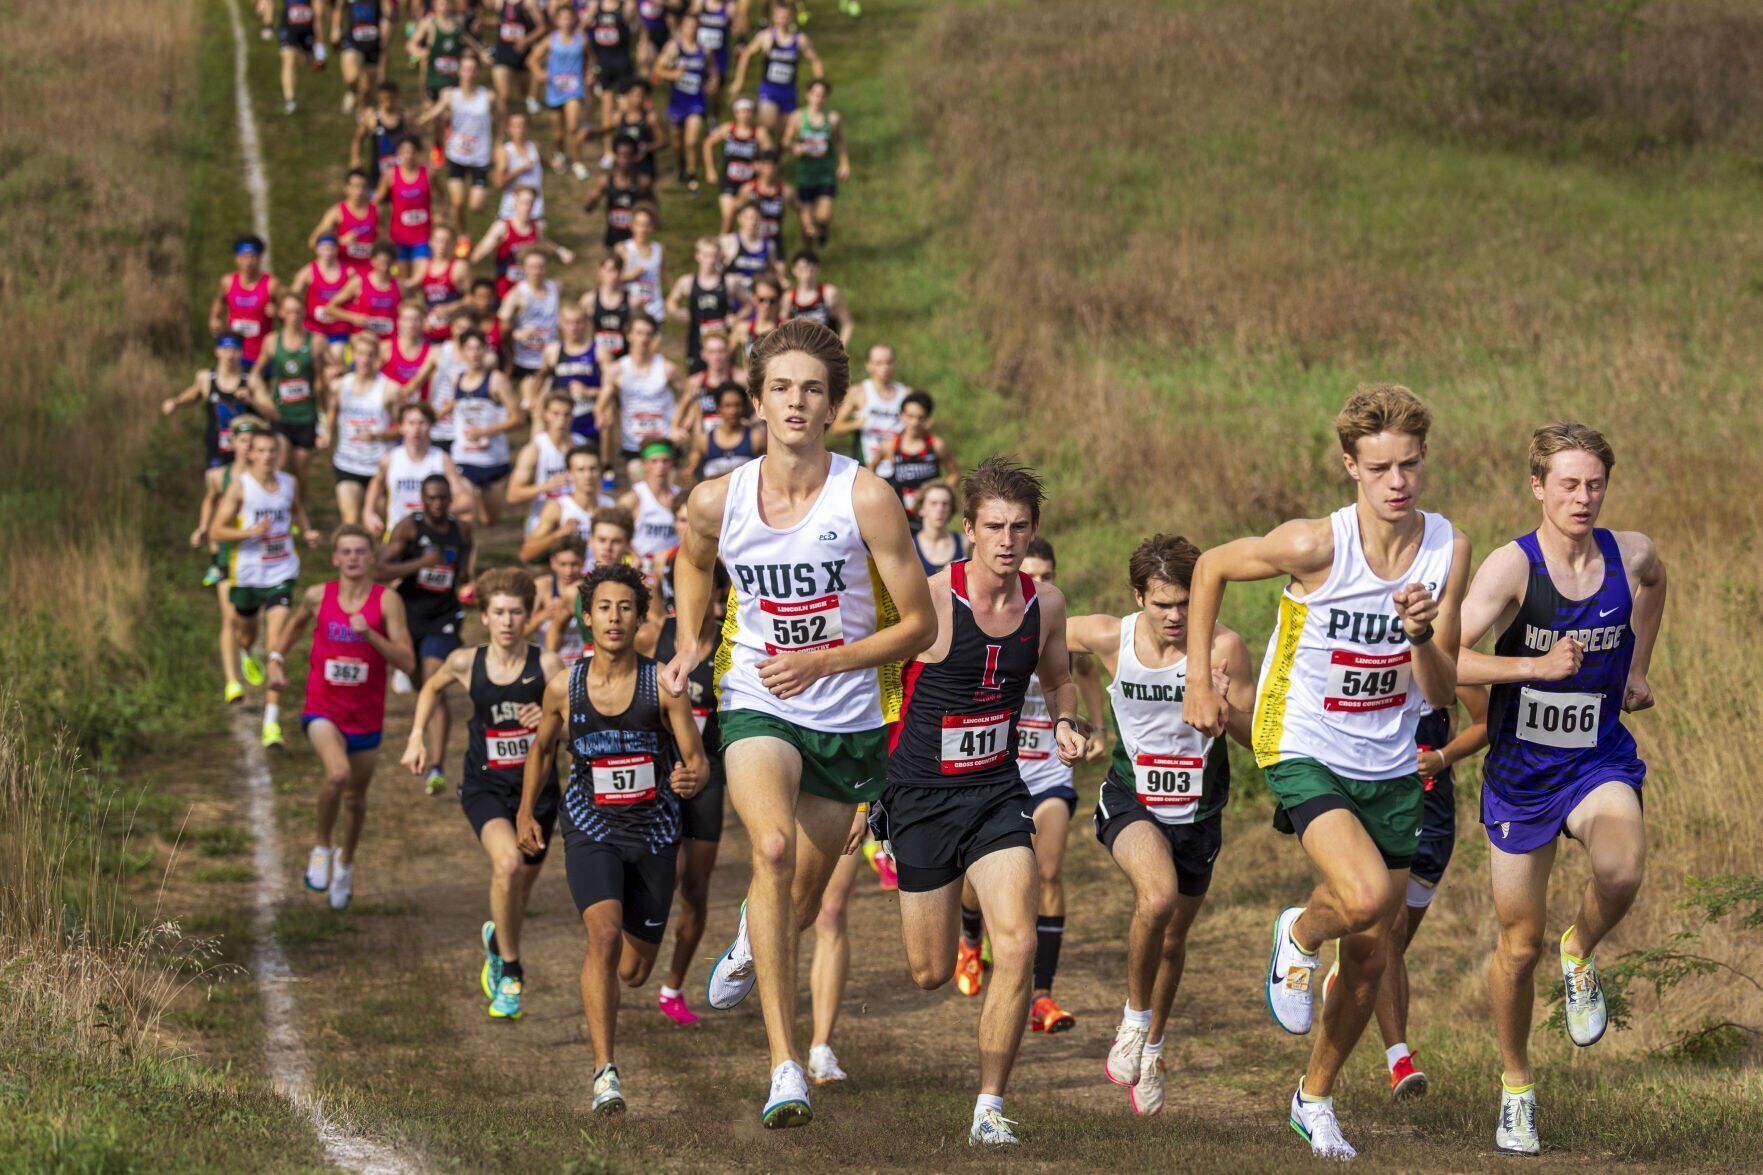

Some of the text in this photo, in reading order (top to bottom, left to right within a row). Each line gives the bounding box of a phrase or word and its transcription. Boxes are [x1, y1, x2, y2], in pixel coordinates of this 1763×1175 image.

[735, 559, 847, 598] PIUS X
[777, 600, 827, 612] LINCOLN HIGH
[773, 616, 828, 645] 552
[1326, 607, 1407, 645] PIUS
[978, 645, 1006, 690] L
[1355, 656, 1386, 665] LINCOLN
[1342, 670, 1398, 697] 549
[1338, 697, 1394, 708] CROSS COUNTRY
[963, 717, 990, 725] LINCOLN
[1525, 702, 1596, 733] 1066
[496, 739, 529, 756] 609
[959, 728, 997, 757] 411
[954, 760, 974, 768] CROSS
[612, 769, 636, 790] 57
[1147, 770, 1191, 793] 903
